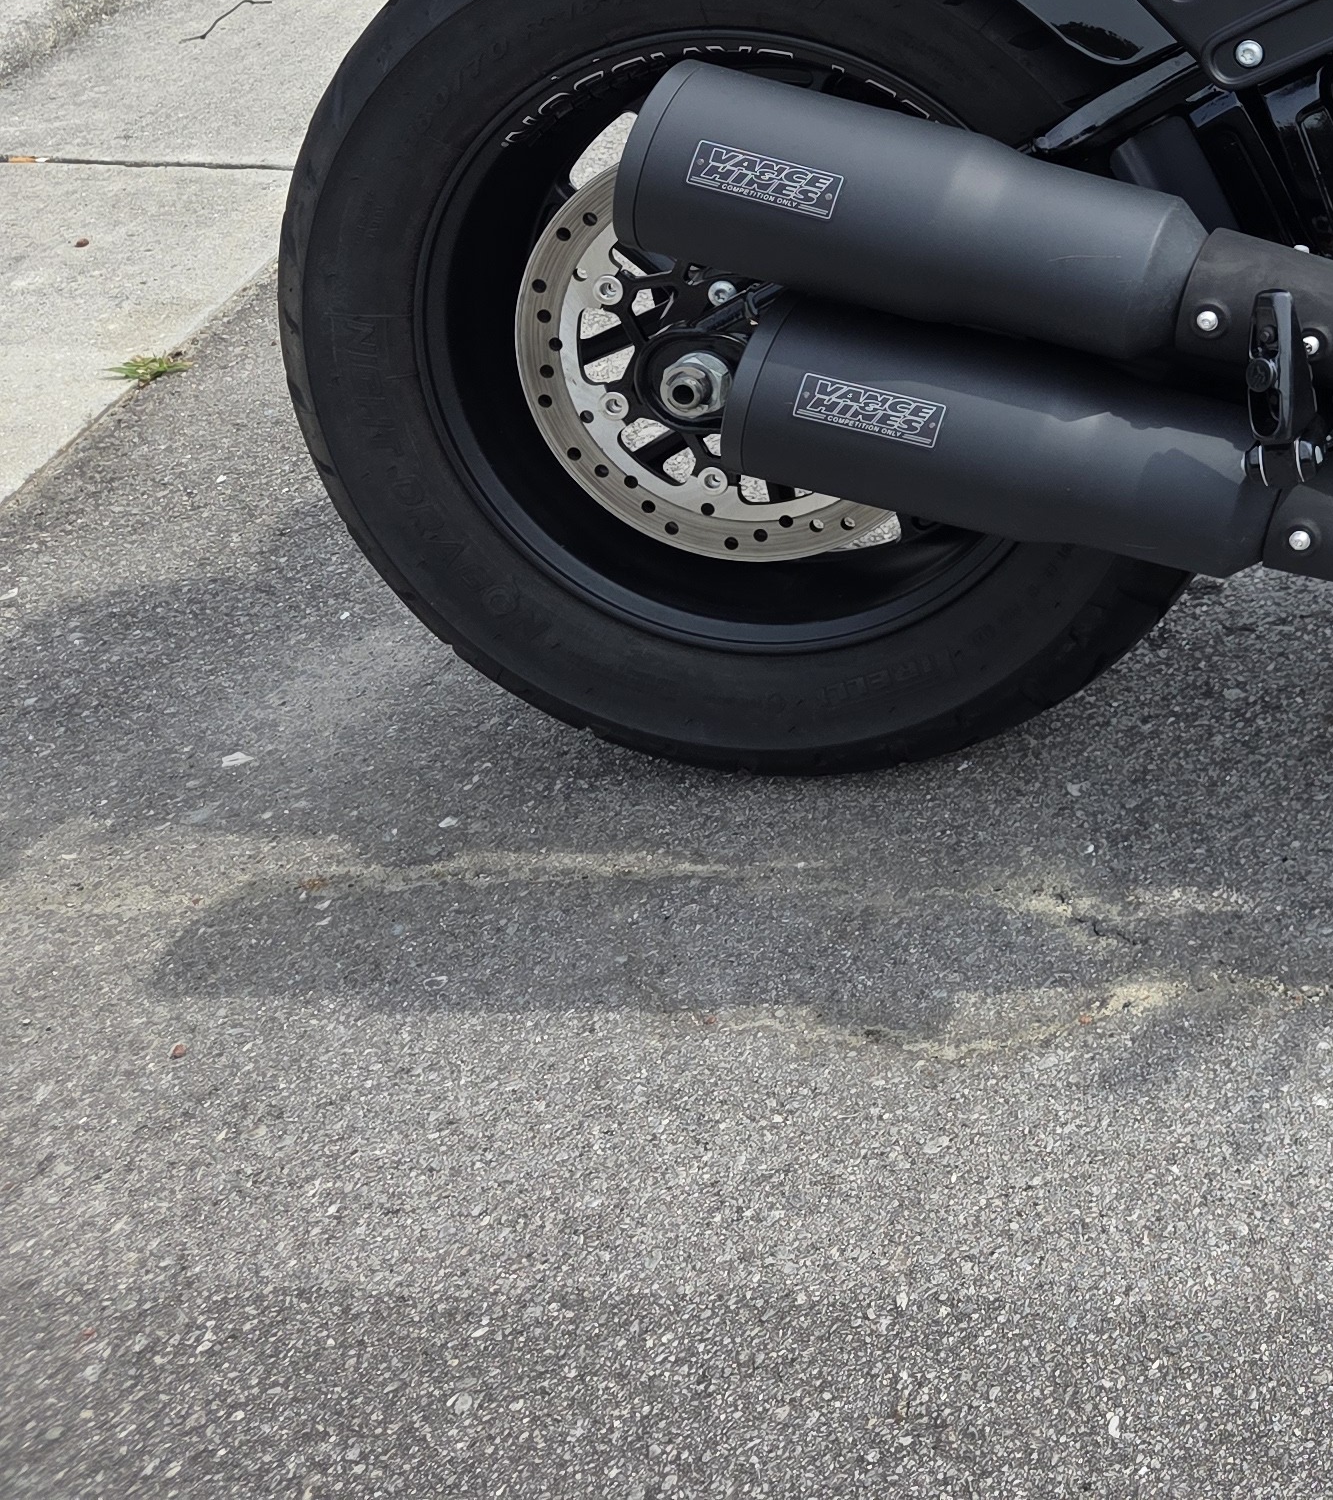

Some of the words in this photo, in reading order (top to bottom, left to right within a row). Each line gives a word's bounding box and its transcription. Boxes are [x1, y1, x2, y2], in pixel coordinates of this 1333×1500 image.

[700, 162, 822, 205] HINES
[709, 148, 834, 192] VANCE
[721, 183, 776, 203] COMPETITION
[777, 198, 798, 208] ONLY
[806, 395, 925, 434] HINES
[815, 379, 937, 422] VANCE
[827, 415, 880, 433] COMPETITION
[881, 428, 902, 438] ONLY
